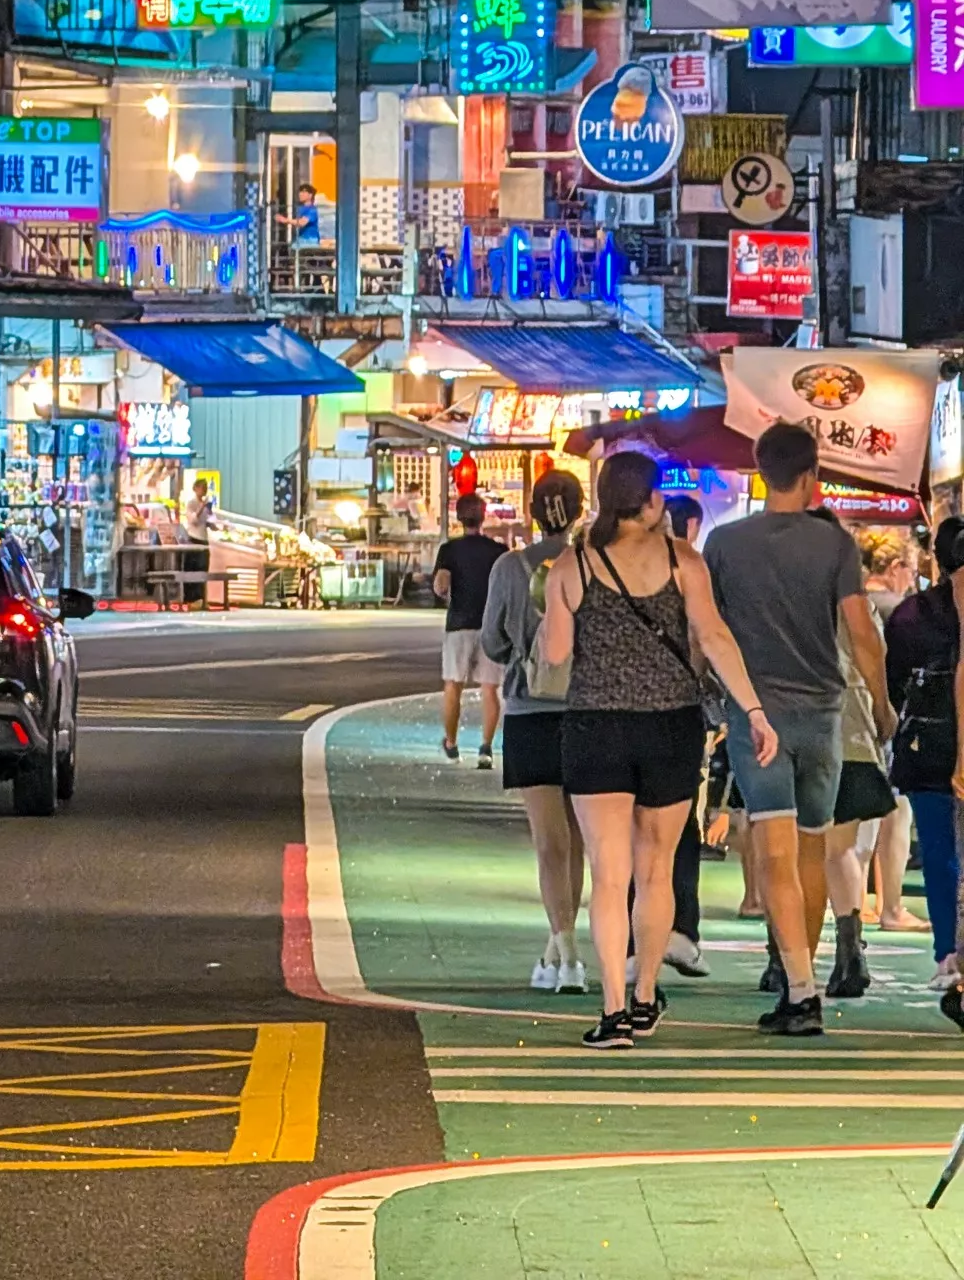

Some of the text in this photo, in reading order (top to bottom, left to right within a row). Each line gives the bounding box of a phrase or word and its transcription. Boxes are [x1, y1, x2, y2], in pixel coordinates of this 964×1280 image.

[931, 8, 948, 76] LAUNDRY
[20, 121, 71, 141] TOP
[17, 208, 70, 219] accessories
